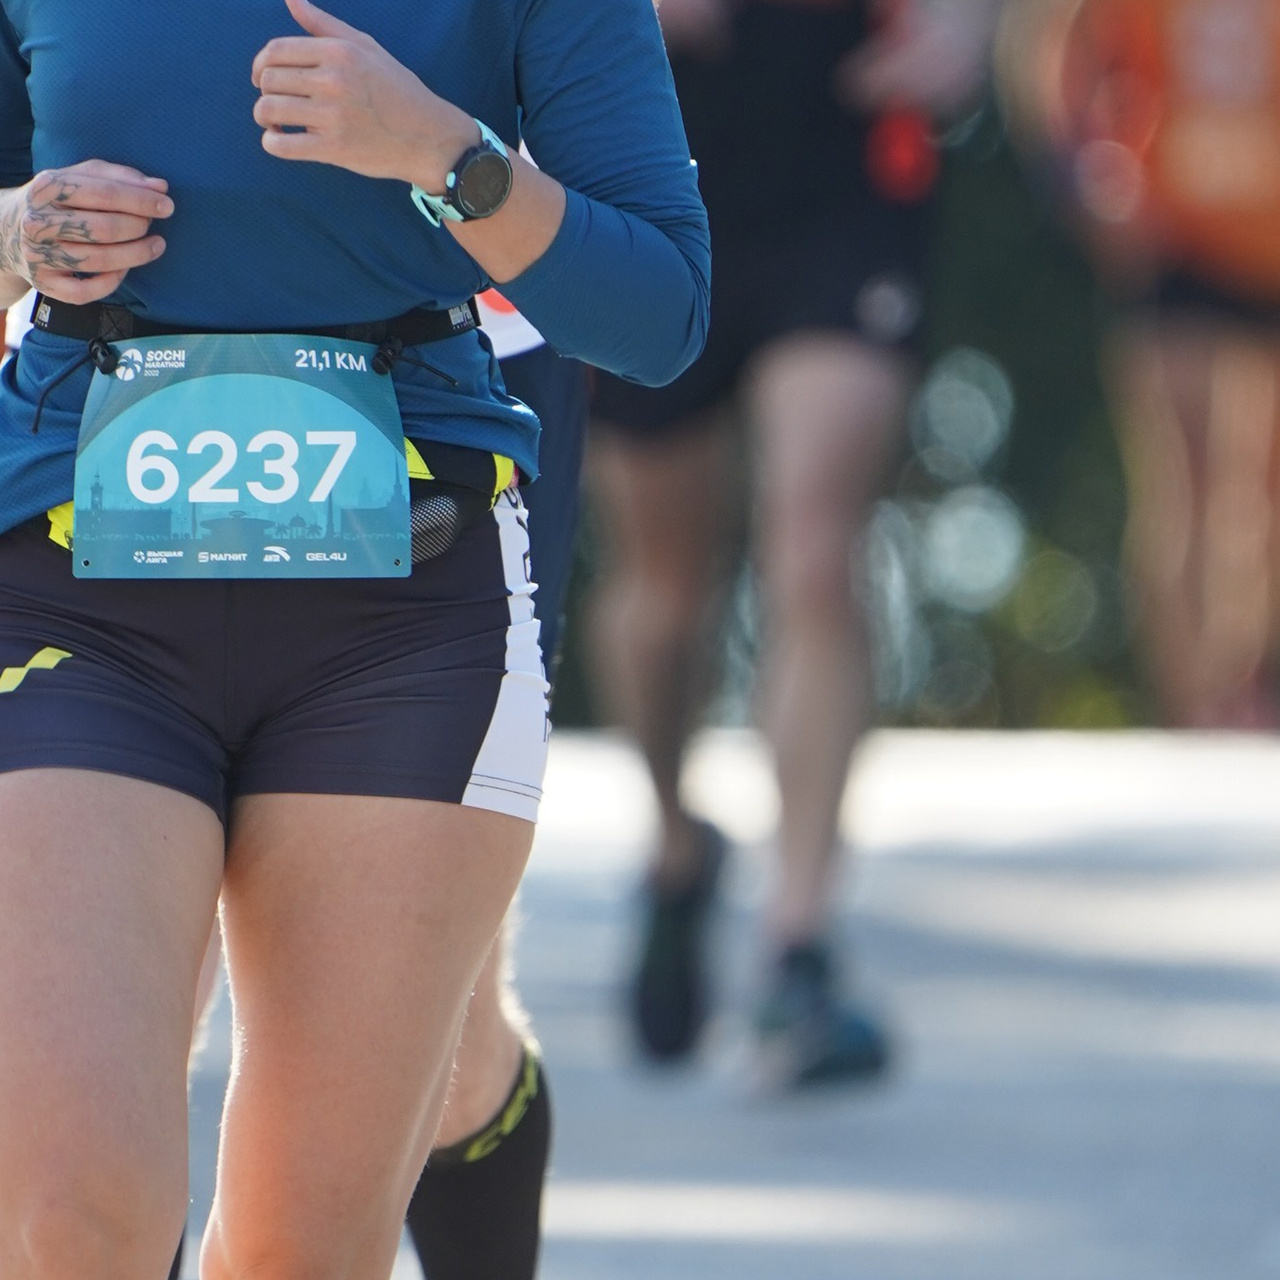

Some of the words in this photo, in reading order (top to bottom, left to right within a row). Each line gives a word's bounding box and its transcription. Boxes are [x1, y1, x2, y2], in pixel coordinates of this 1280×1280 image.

[145, 350, 186, 362] SOCHI
[294, 348, 331, 371] 21,1
[334, 351, 368, 373] KM
[143, 361, 186, 369] MARATHON
[126, 429, 357, 504] 6237
[210, 552, 248, 562] МАГНИТ
[305, 552, 348, 562] GEL4U
